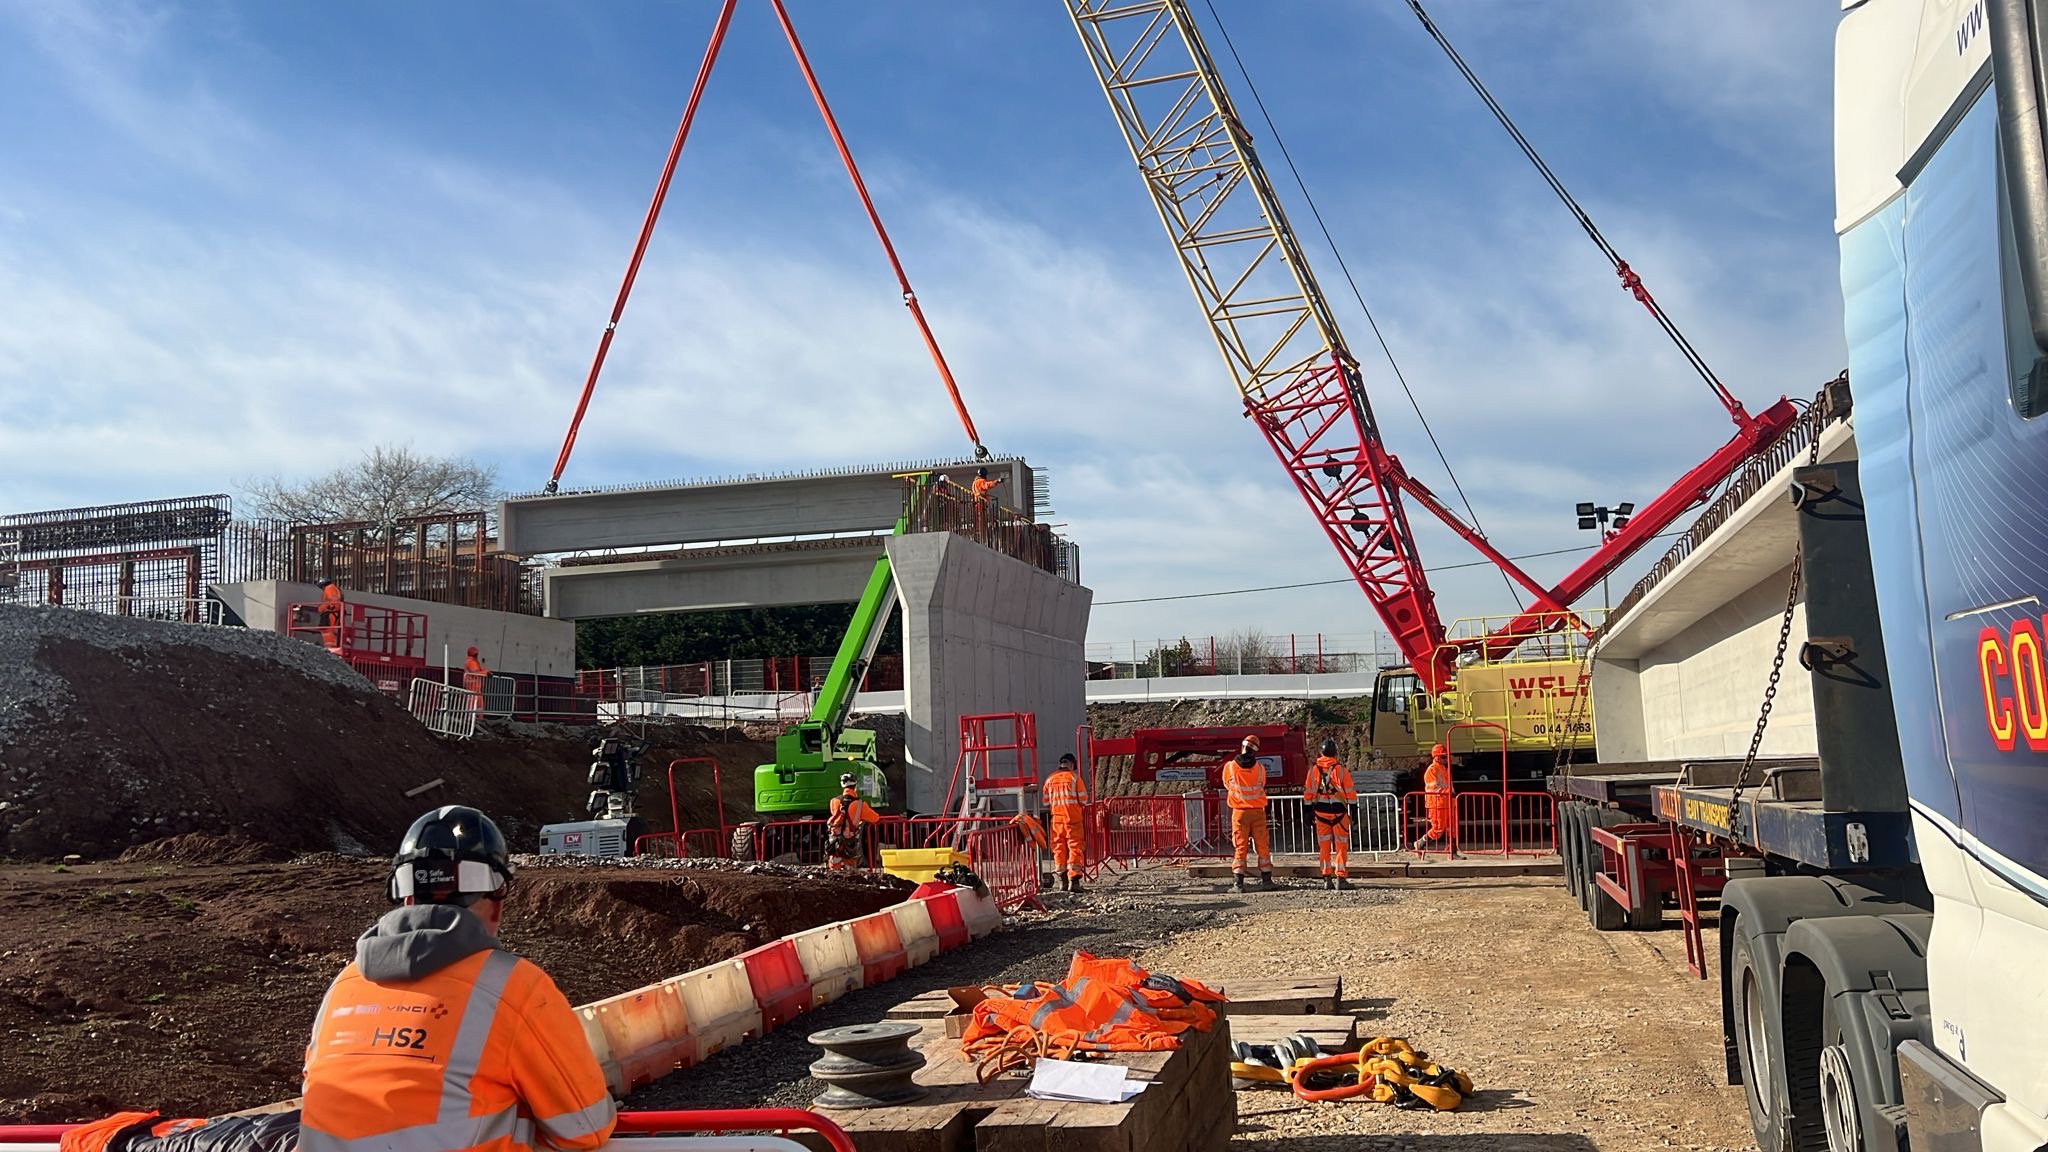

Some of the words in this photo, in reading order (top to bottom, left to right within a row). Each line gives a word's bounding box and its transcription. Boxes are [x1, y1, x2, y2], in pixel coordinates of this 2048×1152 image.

[1533, 724, 1546, 734] 00
[1658, 790, 1681, 820] COLLET
[1700, 800, 1731, 830] TRANSPOR
[387, 1005, 427, 1013] VINCI
[371, 1027, 427, 1049] HS2
